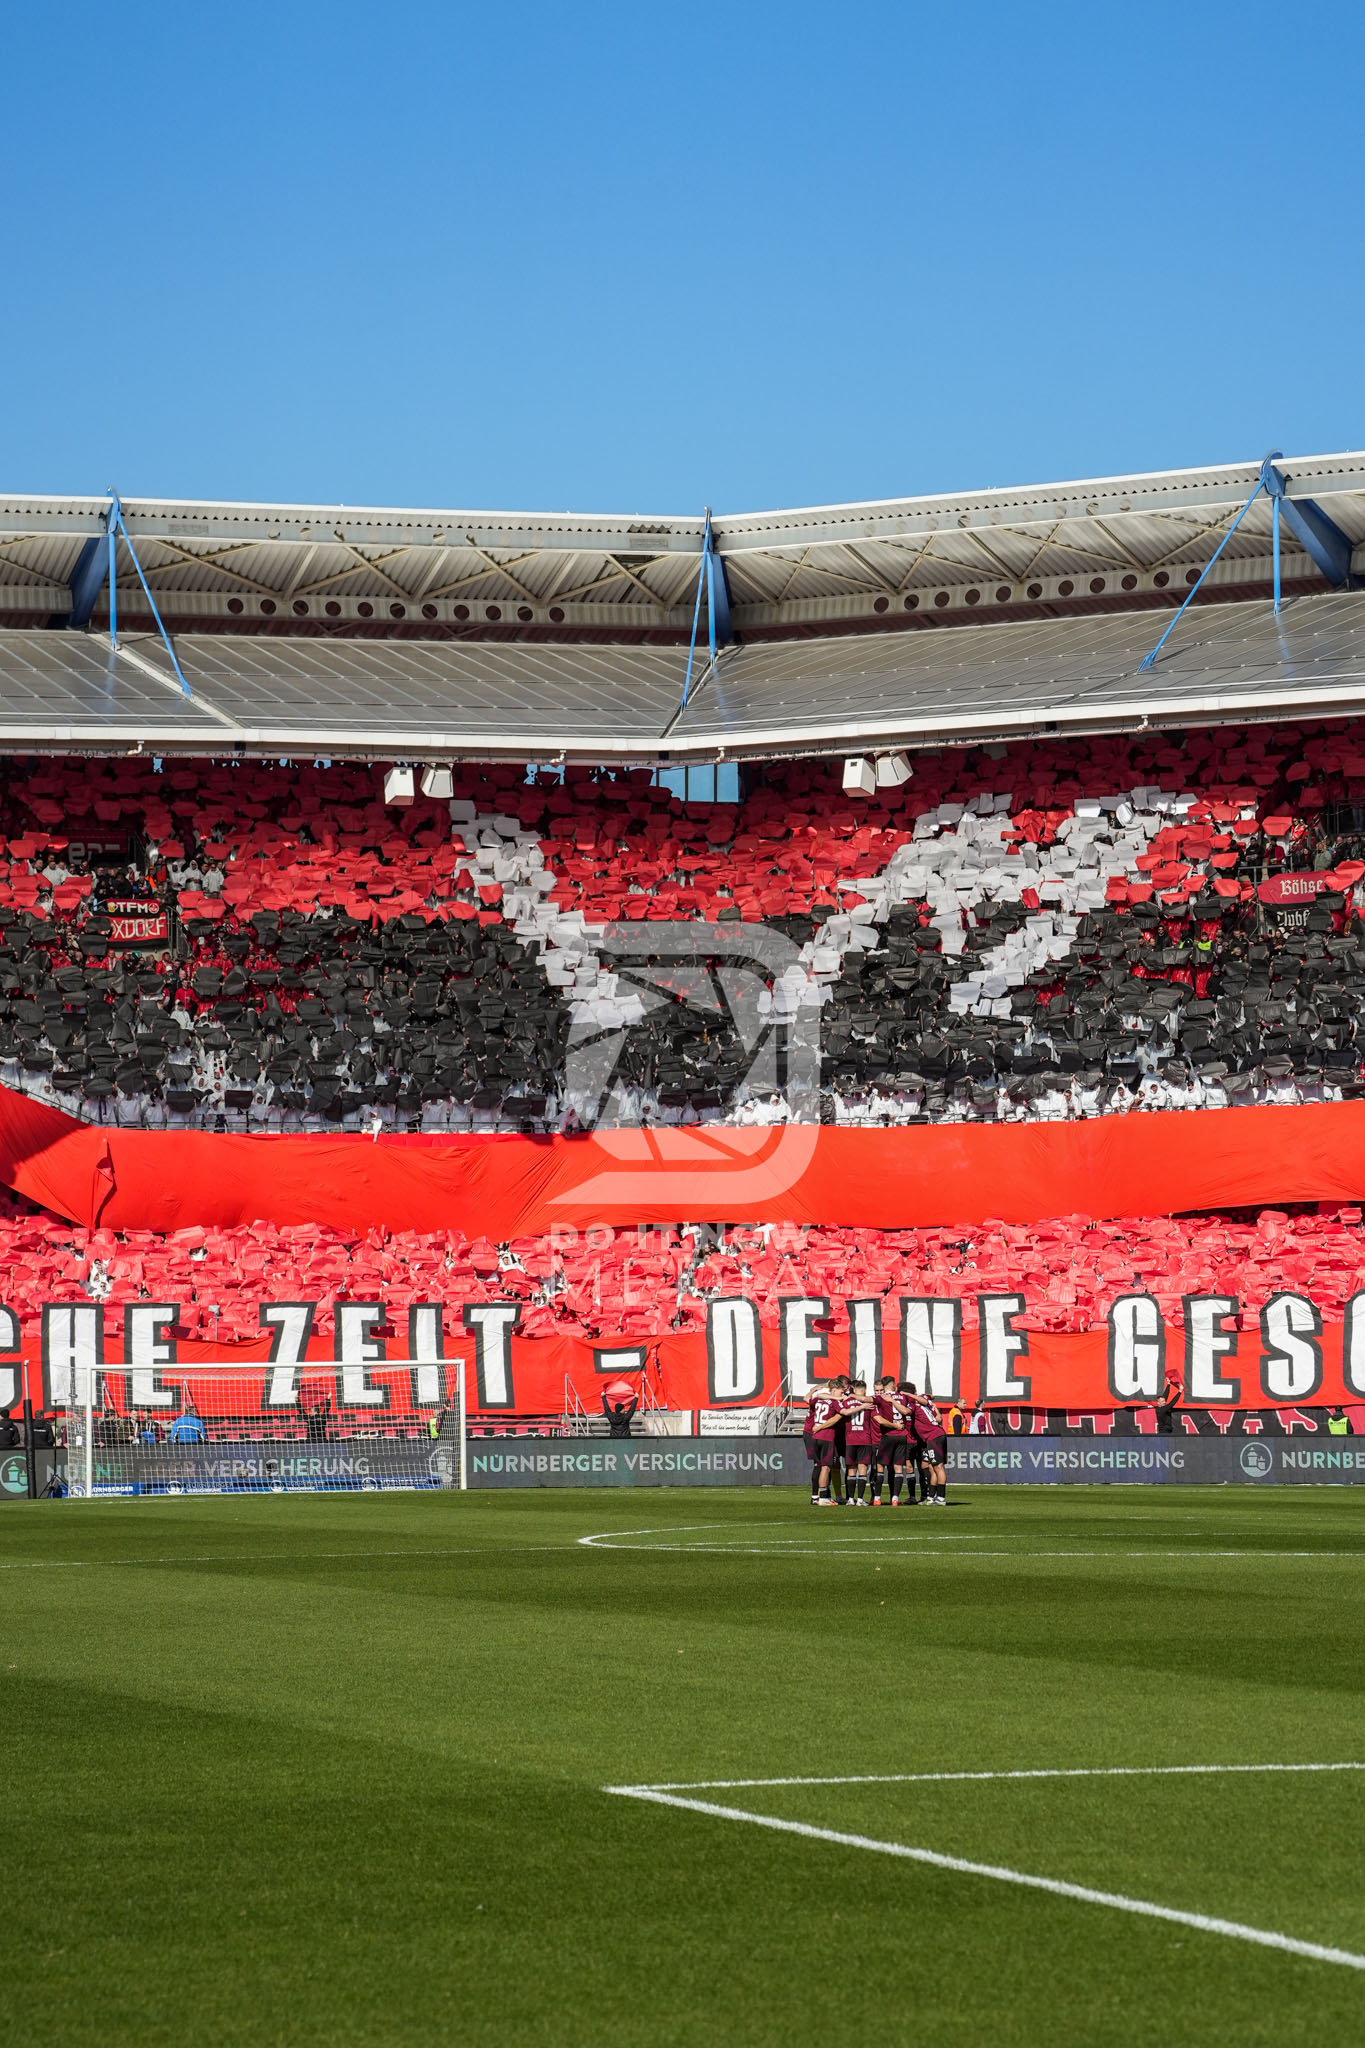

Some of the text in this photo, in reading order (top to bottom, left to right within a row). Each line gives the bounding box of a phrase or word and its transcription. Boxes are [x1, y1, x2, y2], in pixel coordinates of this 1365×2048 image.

[1280, 879, 1323, 897] Böhse
[116, 901, 148, 913] TFM
[1277, 909, 1310, 927] Clubf
[259, 1301, 522, 1411] ZEIT
[706, 1294, 1033, 1404] DEINE
[814, 1402, 829, 1424] 32
[204, 1457, 369, 1477] VERSICHERUNG
[473, 1452, 783, 1473] NÜRNBERGER VERSICHERUNG
[946, 1450, 1185, 1469] BERGER VERSICHERUNG
